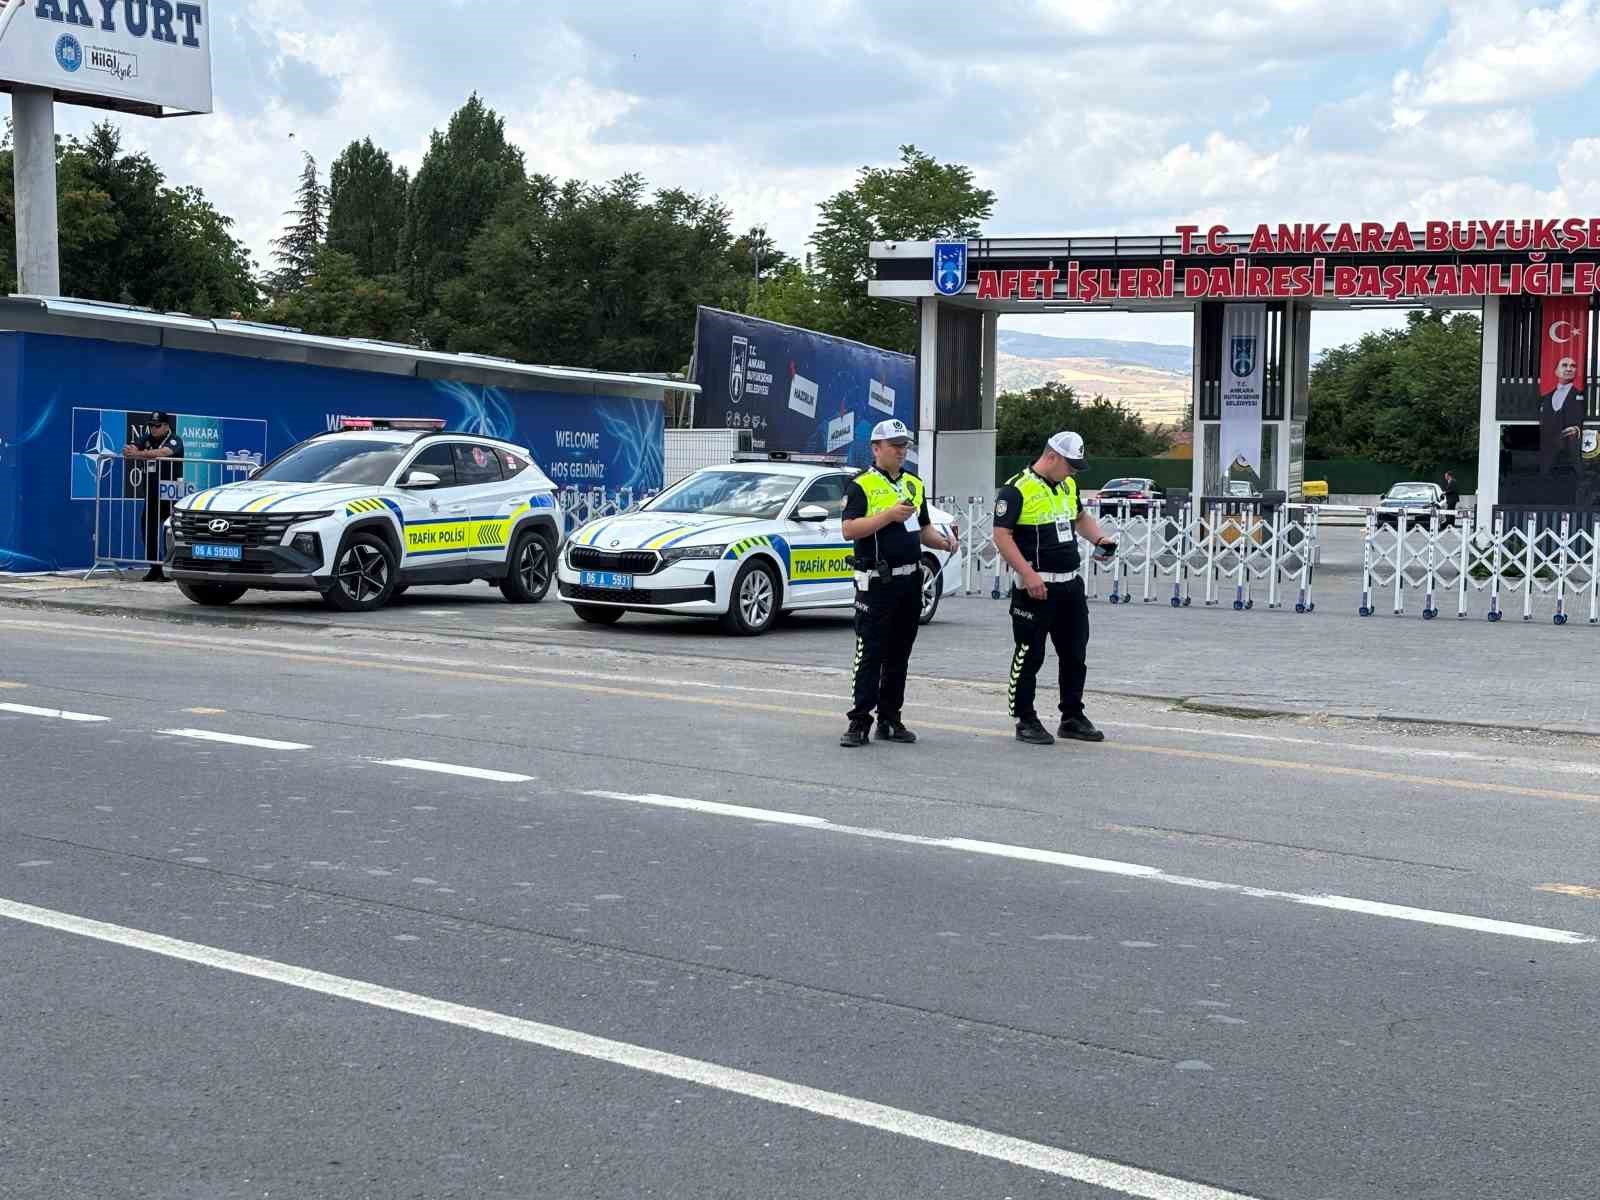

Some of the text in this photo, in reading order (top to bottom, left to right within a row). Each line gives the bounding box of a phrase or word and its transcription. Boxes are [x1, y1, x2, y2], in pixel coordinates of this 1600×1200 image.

[1175, 225, 1239, 256] T.C.
[1249, 221, 1415, 253] ANKARA
[976, 270, 1060, 299] AFET
[1068, 259, 1175, 303] İŞLERİ
[1184, 258, 1326, 298] DAİRESİ
[1334, 252, 1563, 300] BAŞKANLIĞI
[182, 426, 219, 440] ANKARA
[556, 431, 600, 449] WELCOME
[551, 458, 605, 480] HOŞ GELDİNİZ
[408, 527, 465, 544] TRAFİK POLİSİ
[206, 546, 212, 556] A
[795, 556, 826, 574] TRAFİK
